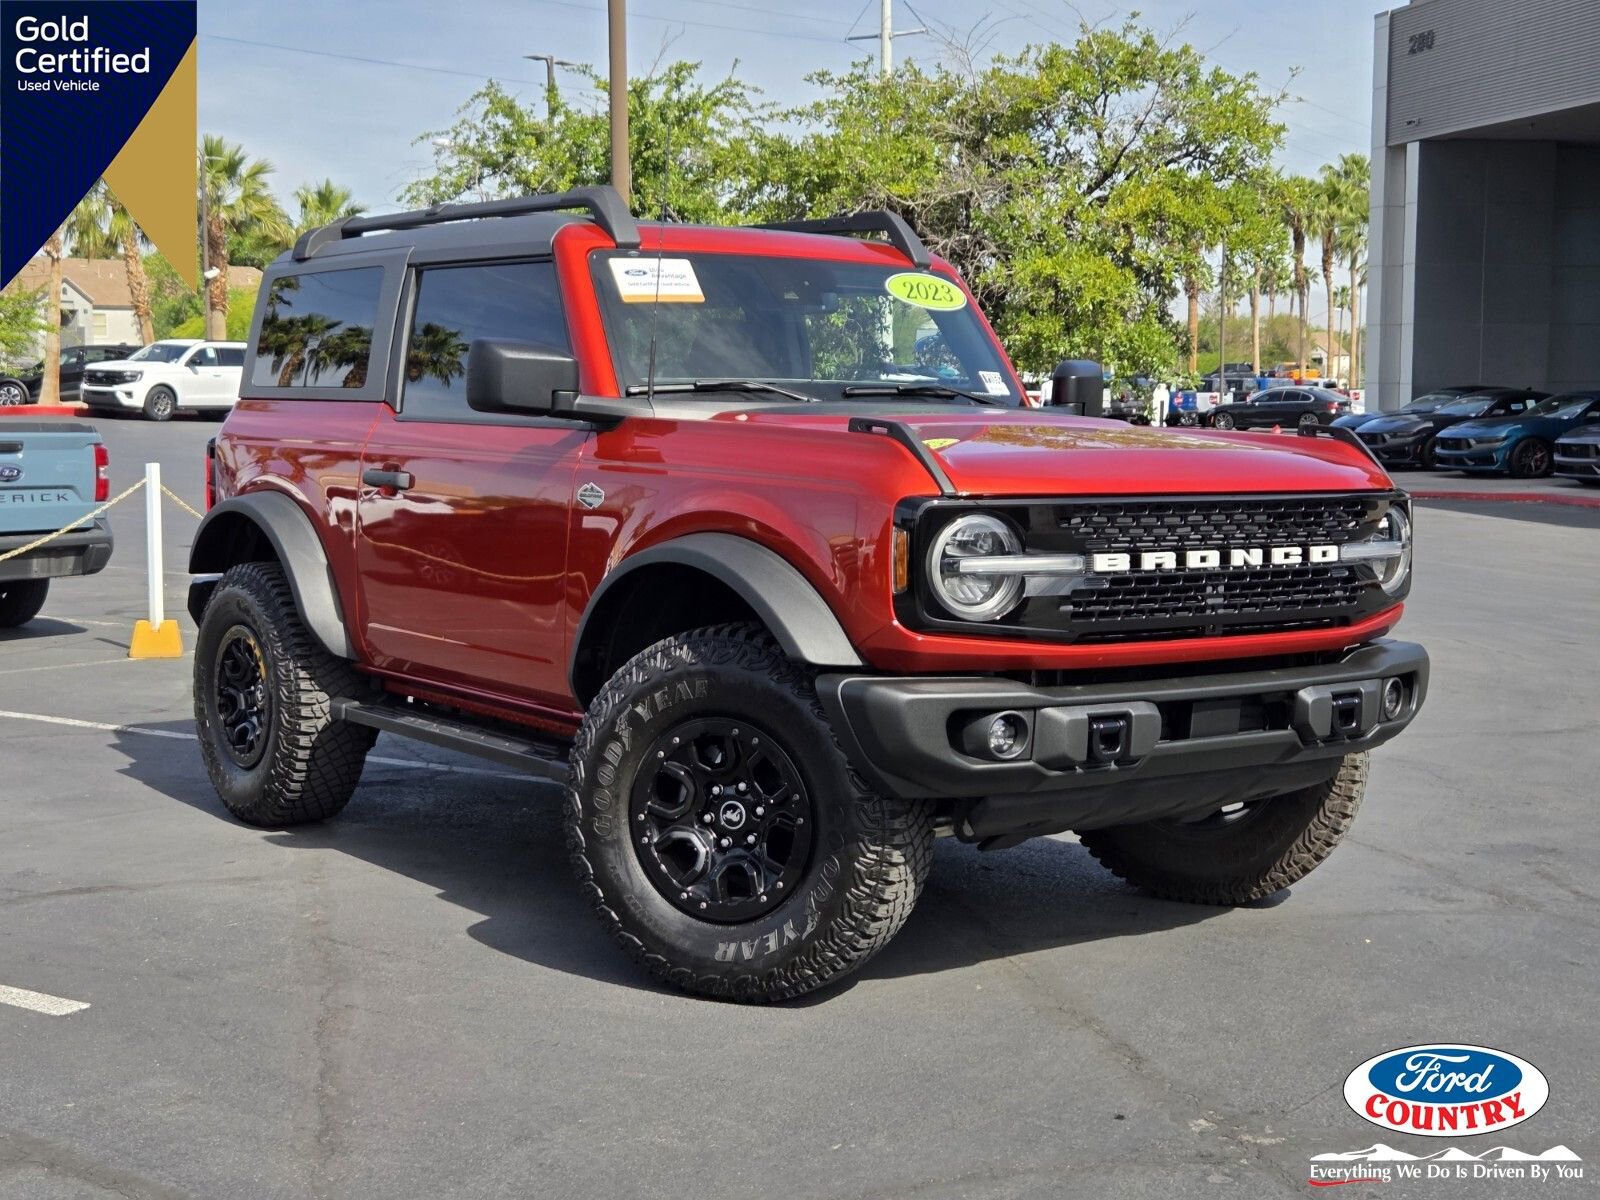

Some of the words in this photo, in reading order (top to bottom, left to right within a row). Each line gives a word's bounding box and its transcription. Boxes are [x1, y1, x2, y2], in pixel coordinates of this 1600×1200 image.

[903, 280, 954, 303] 2023
[1093, 545, 1339, 572] BRONCO
[593, 679, 711, 837] GOODYEAR
